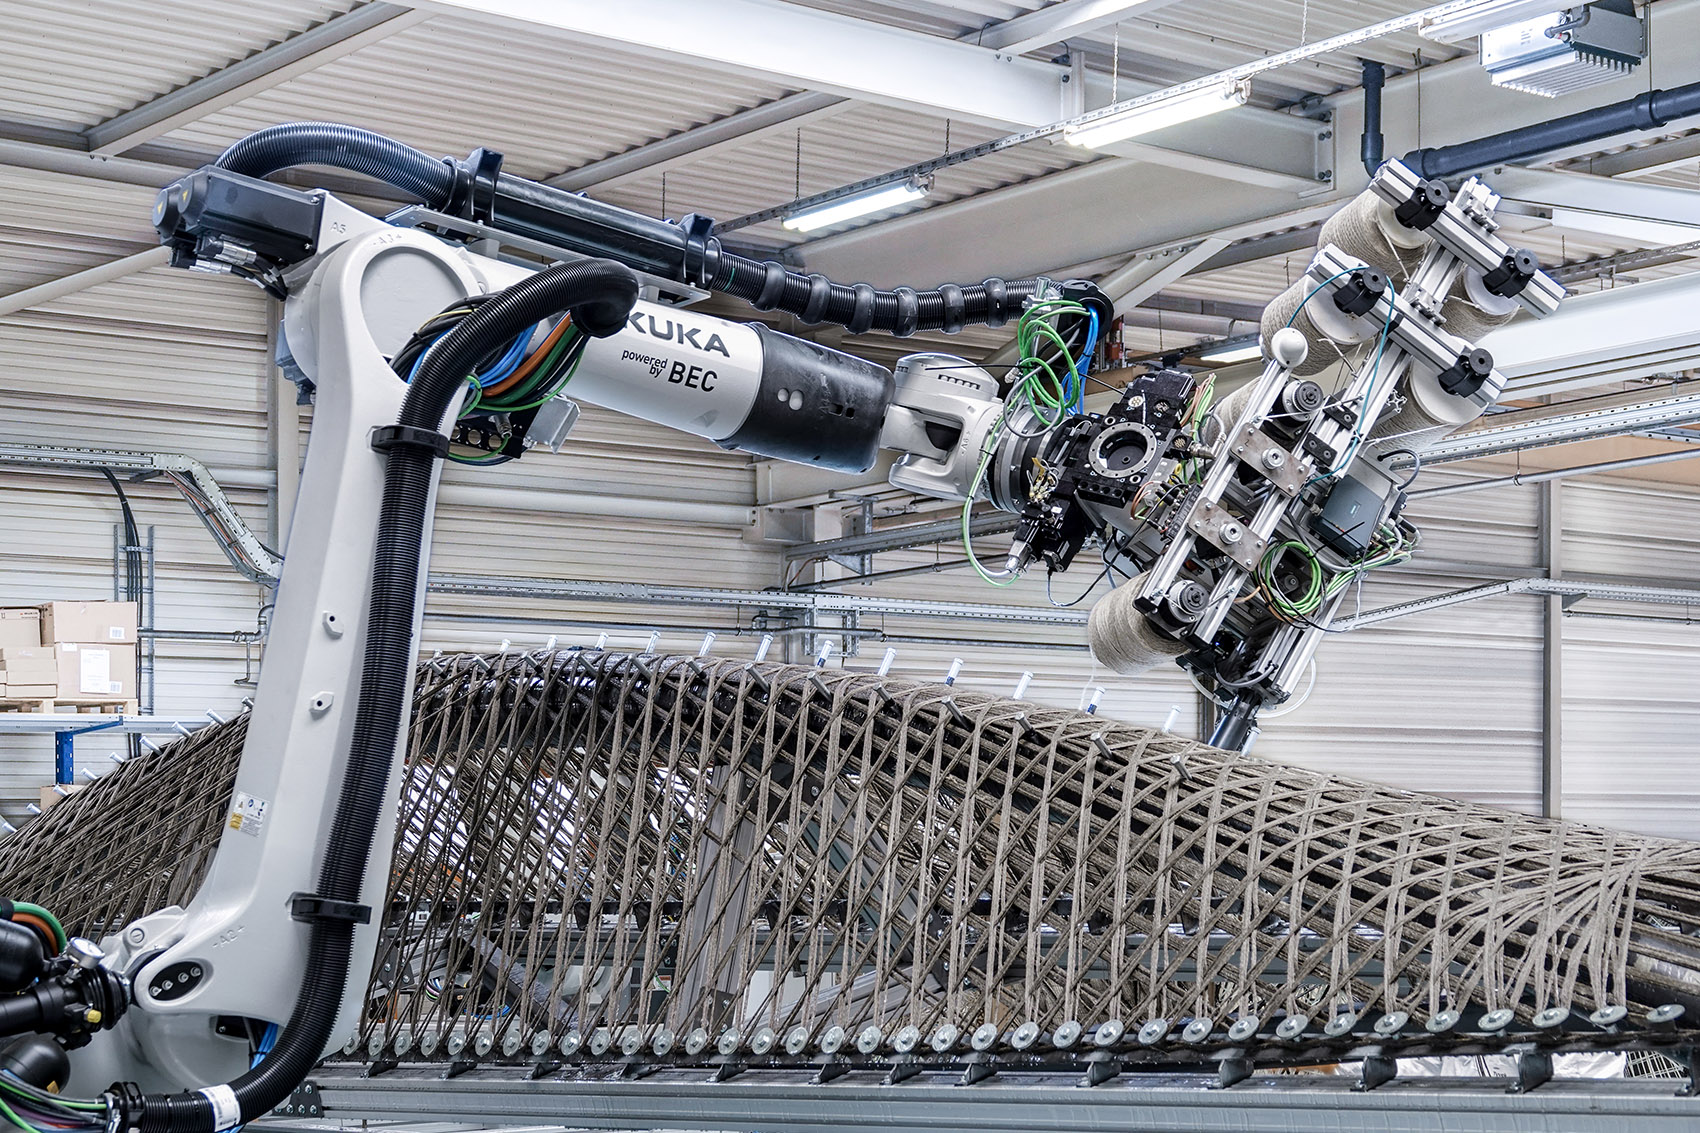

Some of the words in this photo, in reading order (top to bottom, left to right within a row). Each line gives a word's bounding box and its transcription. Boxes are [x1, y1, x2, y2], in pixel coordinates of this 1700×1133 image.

[625, 311, 730, 358] KUKA
[621, 350, 668, 369] powered
[649, 364, 663, 378] by
[668, 361, 718, 392] BEC
